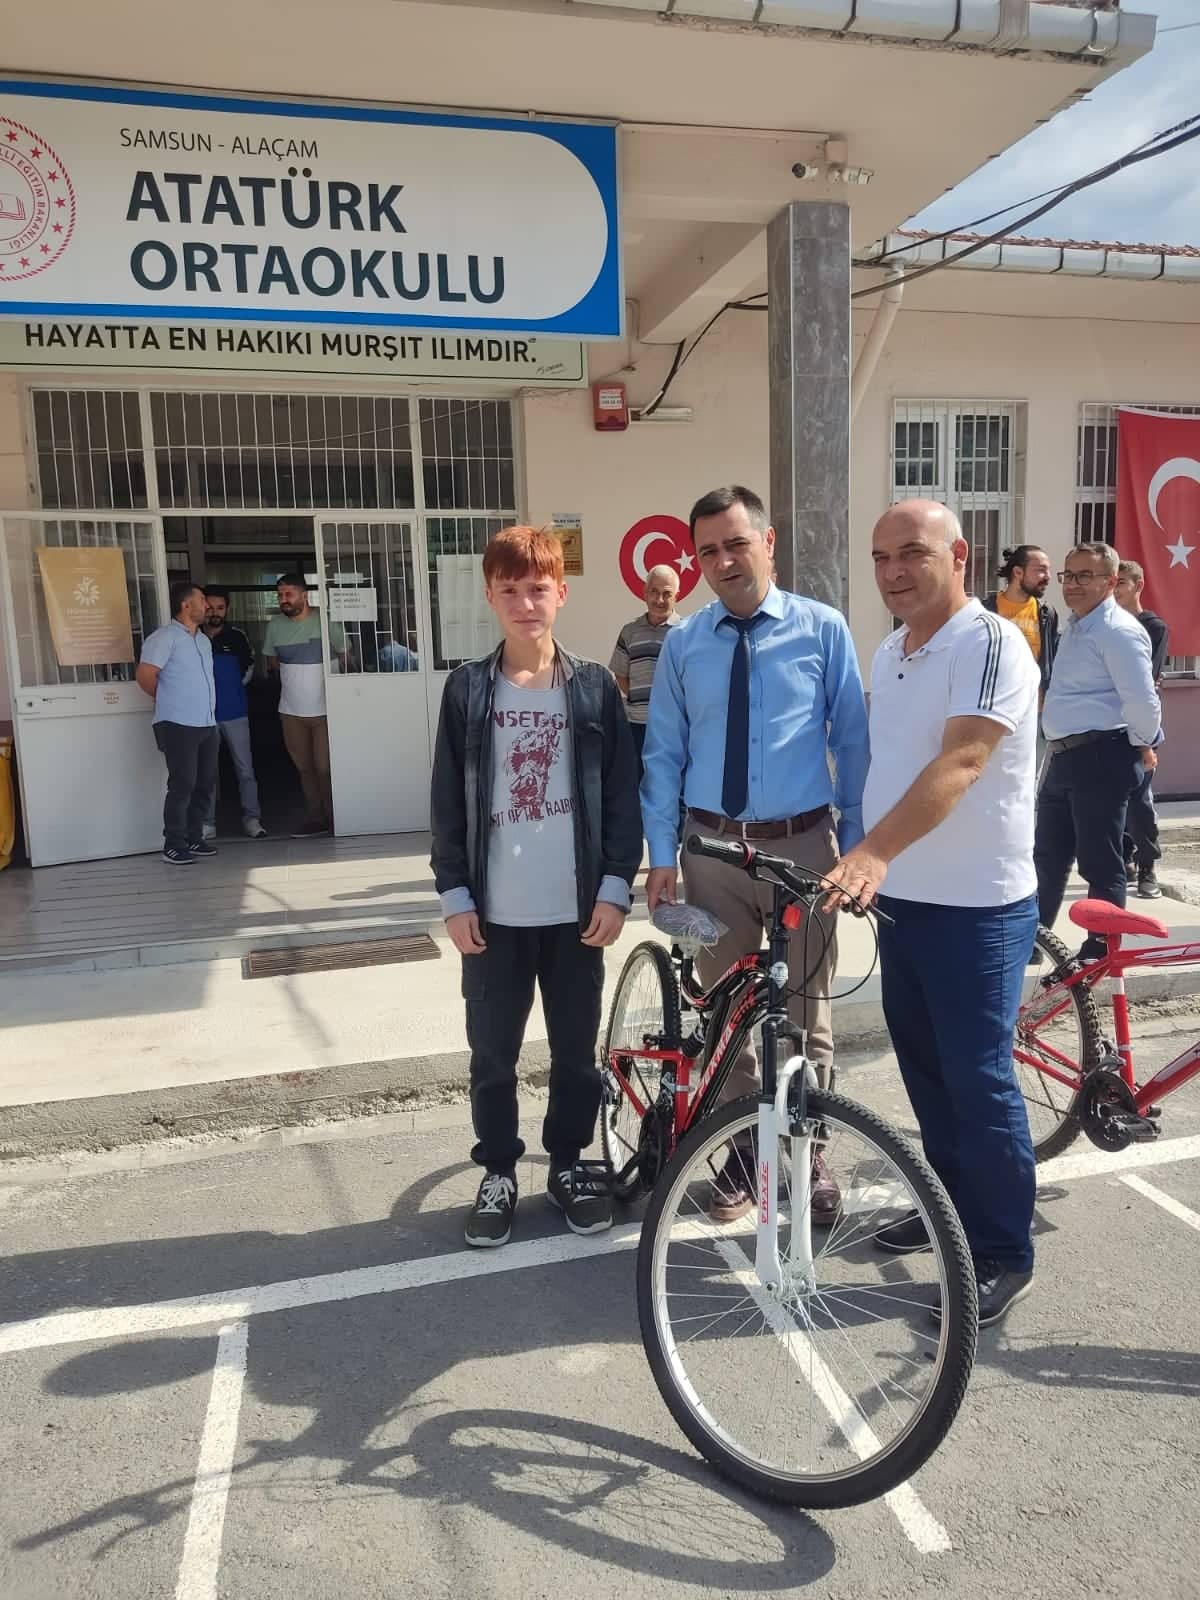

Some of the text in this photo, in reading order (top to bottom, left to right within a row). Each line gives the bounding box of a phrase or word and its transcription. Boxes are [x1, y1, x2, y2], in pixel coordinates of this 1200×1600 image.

[120, 128, 212, 152] SAMSUN
[231, 136, 319, 161] ALAÇAM
[126, 166, 408, 234] ATATÜRK
[130, 240, 505, 304] ORTAOKULU
[25, 323, 160, 350] HAYATTA
[169, 327, 207, 351] EN
